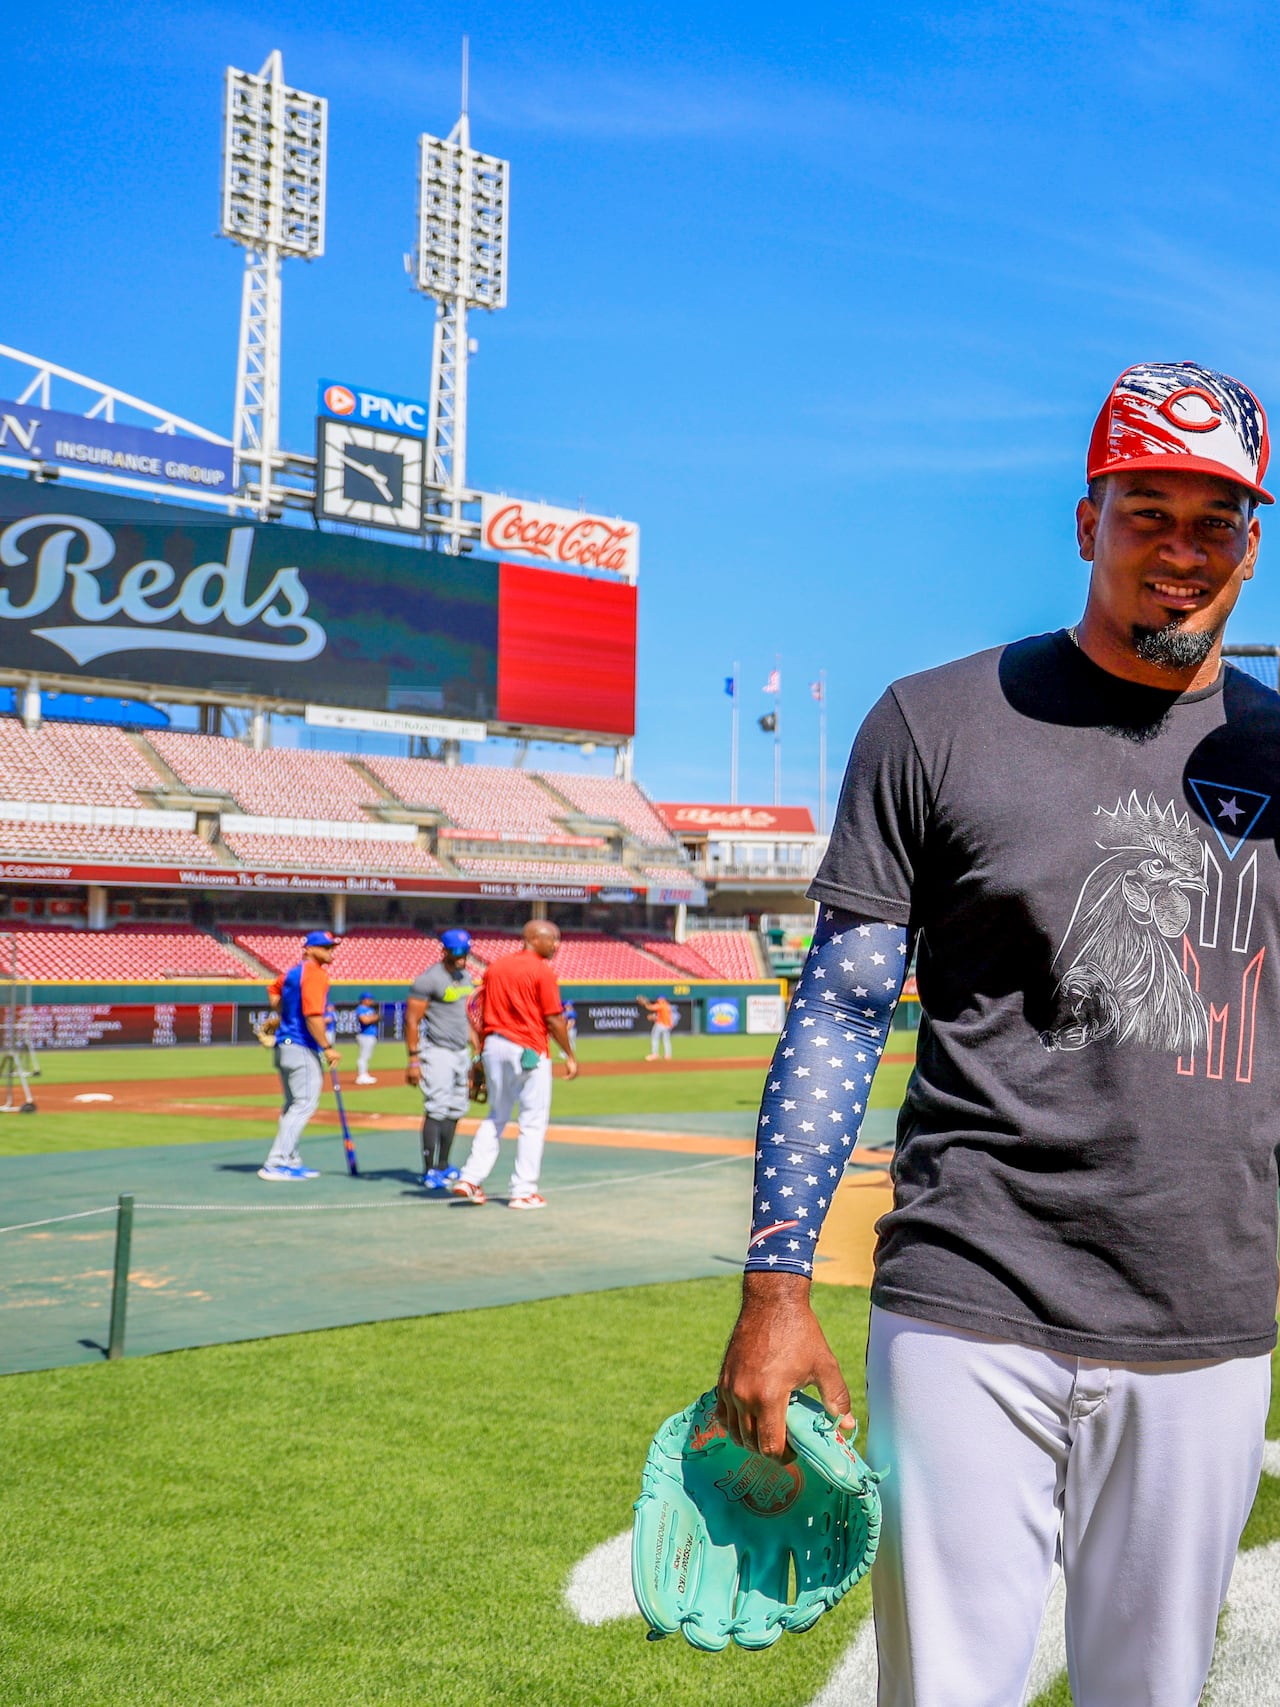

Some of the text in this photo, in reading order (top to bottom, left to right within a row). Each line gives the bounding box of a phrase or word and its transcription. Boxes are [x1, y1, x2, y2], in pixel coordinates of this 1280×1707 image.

[358, 392, 426, 430] PNC
[1158, 386, 1222, 433] C
[55, 440, 162, 476] INSURANCE
[164, 461, 226, 486] GROUP
[0, 513, 327, 667] Reds
[179, 871, 237, 885] Welcome
[254, 873, 288, 887] Great
[289, 875, 345, 890] American
[346, 877, 367, 890] Ball
[369, 879, 396, 891] Park
[589, 1006, 639, 1019] NATIONAL
[594, 1017, 633, 1030] LEAGUE
